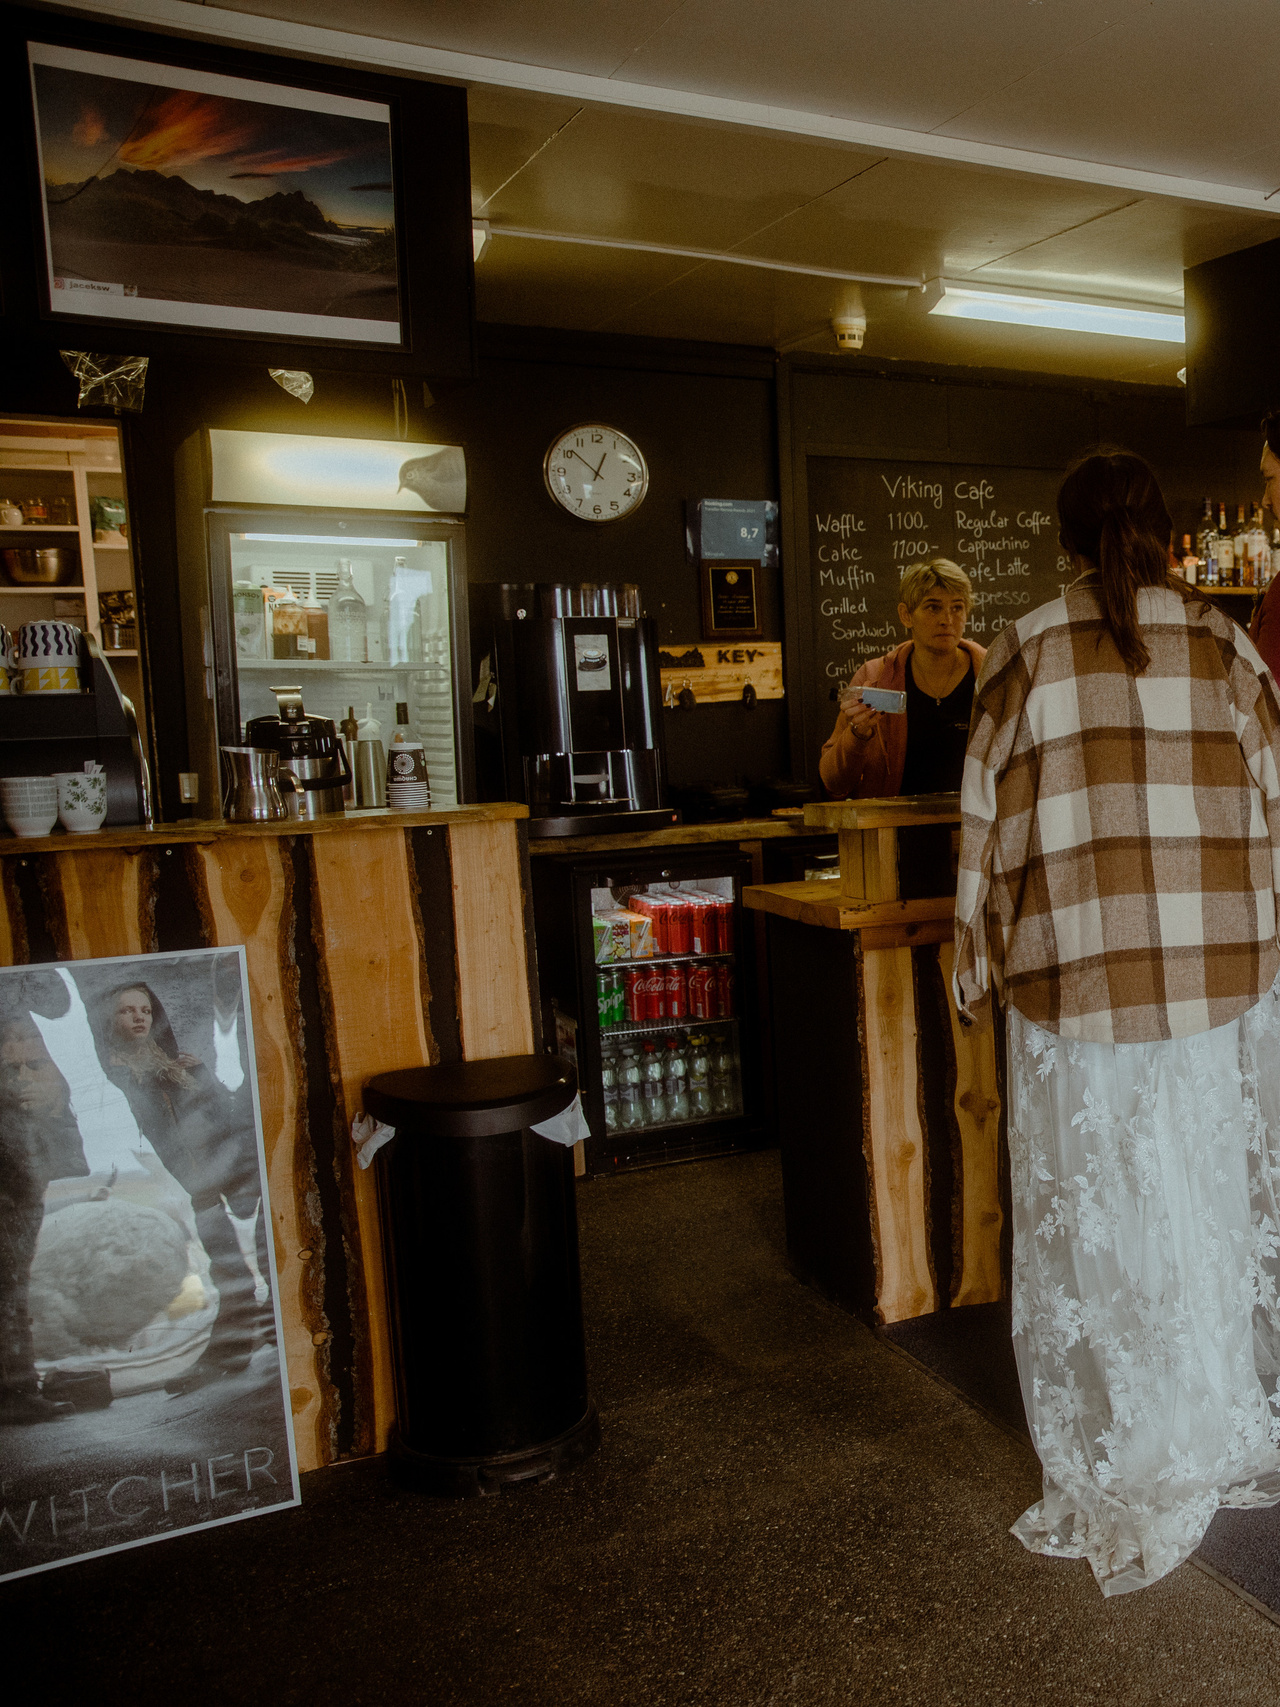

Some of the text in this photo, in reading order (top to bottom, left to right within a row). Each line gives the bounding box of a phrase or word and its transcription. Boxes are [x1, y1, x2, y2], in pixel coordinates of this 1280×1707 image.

[576, 437, 584, 448] 11
[591, 433, 604, 444] 12
[557, 467, 567, 477] 9
[627, 472, 637, 483] 3
[623, 488, 632, 497] 4
[881, 474, 995, 510] Viking Cafe
[576, 498, 583, 508] 7
[593, 505, 602, 515] 6
[610, 501, 619, 511] 5
[740, 527, 759, 539] 8,7
[816, 513, 867, 539] Waffle
[955, 510, 1051, 538] Regular Coffee
[818, 545, 862, 563] Cake
[957, 537, 1031, 562] Cappuchino
[996, 557, 1031, 577] Latte
[819, 566, 875, 590] Muffin
[820, 597, 868, 616] Grilled
[973, 591, 1031, 611] spresso
[832, 619, 897, 640] Sandwich
[717, 649, 758, 664] KEY
[825, 658, 868, 678] Grille
